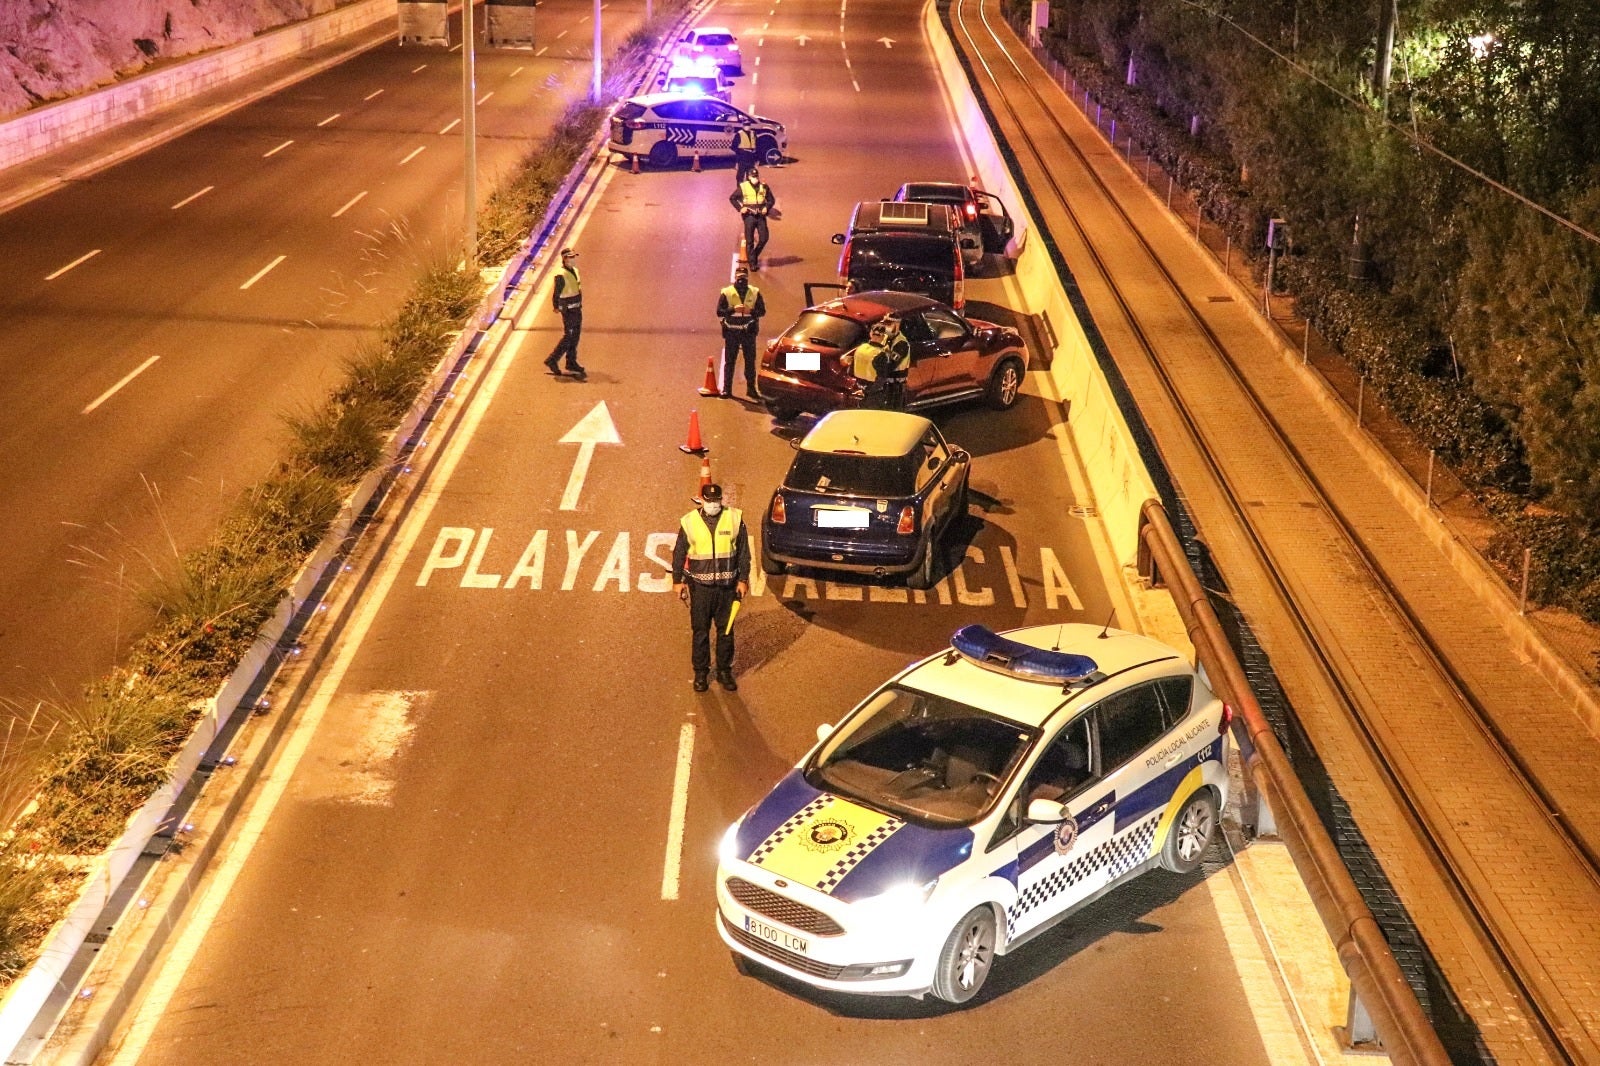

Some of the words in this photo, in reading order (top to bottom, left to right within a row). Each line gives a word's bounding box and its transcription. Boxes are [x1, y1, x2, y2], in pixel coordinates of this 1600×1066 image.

[415, 527, 677, 593] PLAYAS
[747, 535, 1084, 610] VCIA
[1168, 736, 1187, 754] LOCAL
[1186, 718, 1210, 741] ALICANTE
[751, 920, 778, 942] 8100
[785, 935, 807, 954] LCM
